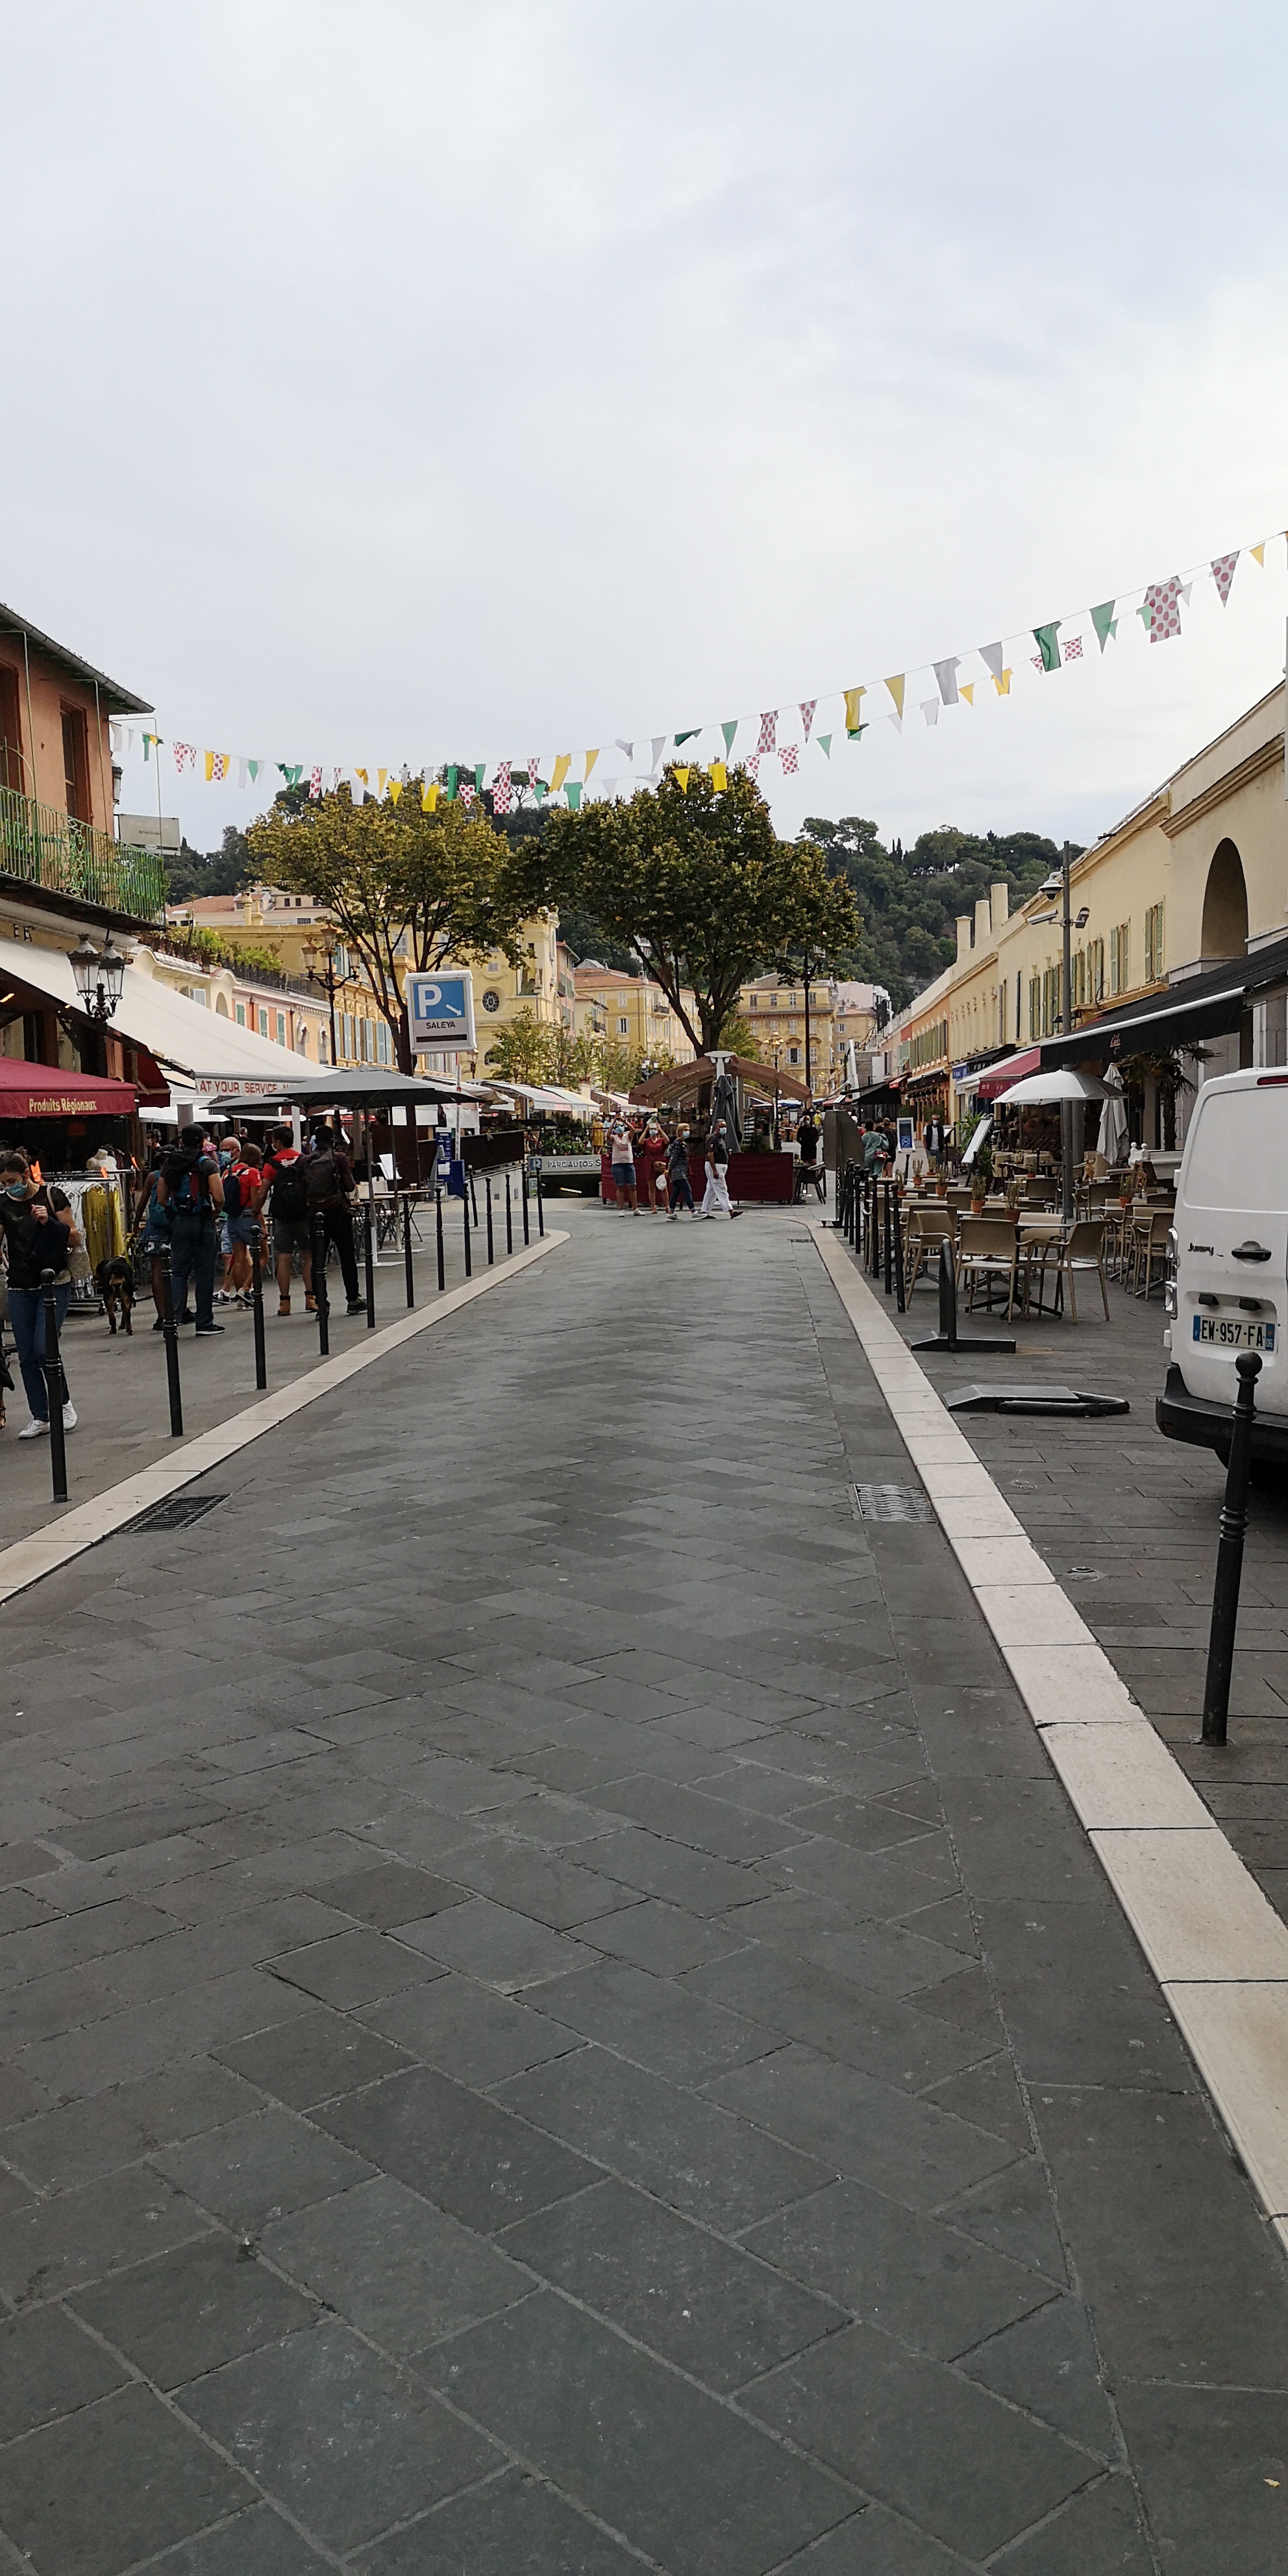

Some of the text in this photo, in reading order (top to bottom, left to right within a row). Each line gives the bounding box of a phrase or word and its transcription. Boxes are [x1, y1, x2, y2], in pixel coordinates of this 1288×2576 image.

[418, 984, 441, 1017] P
[200, 1080, 277, 1093] AT YOUR SERVICE
[29, 1098, 97, 1115] Produits Régionaux
